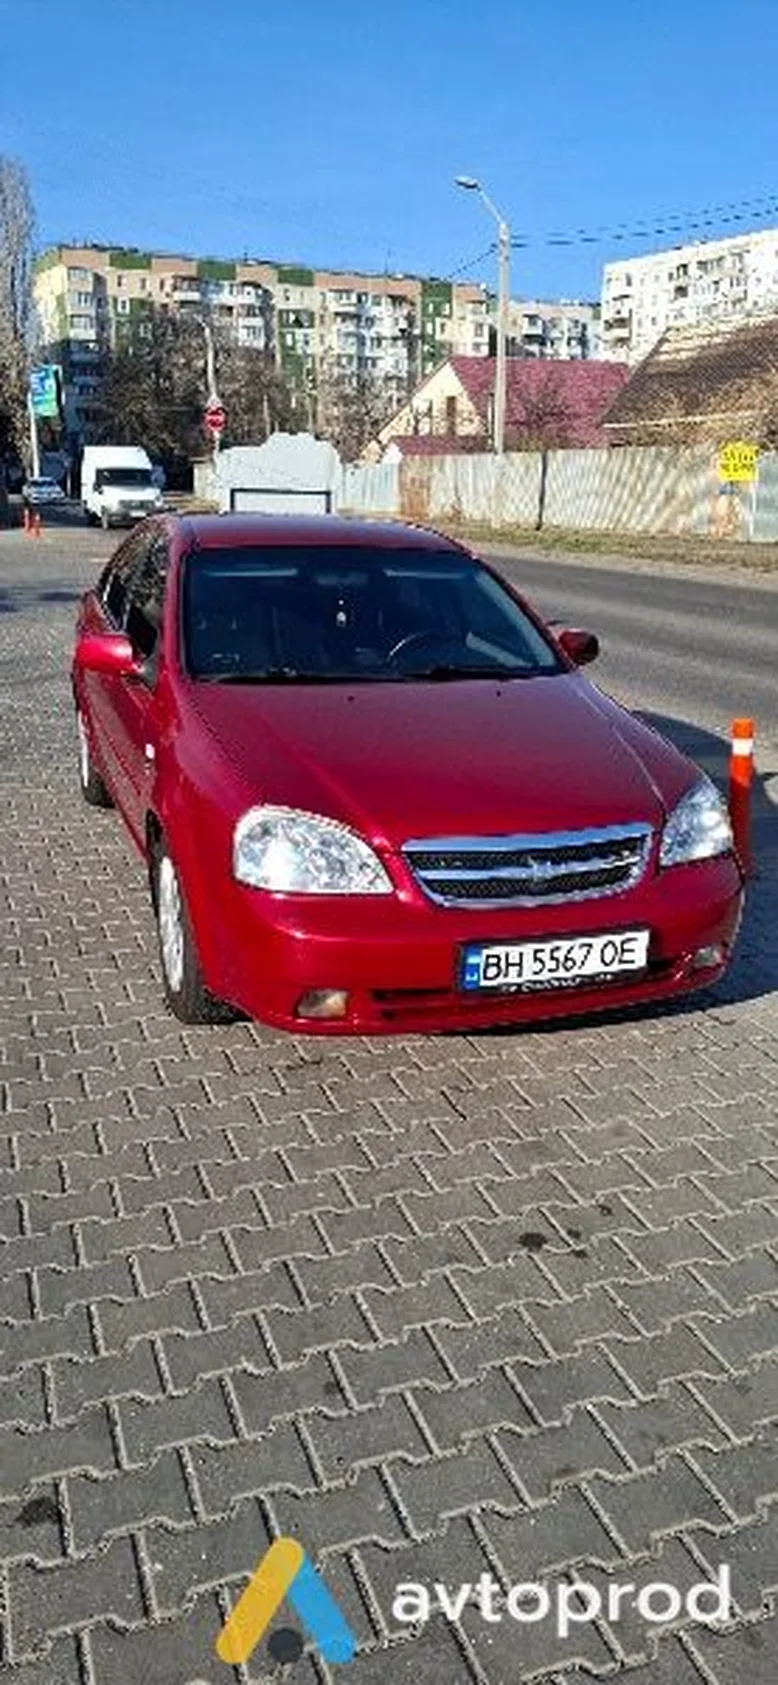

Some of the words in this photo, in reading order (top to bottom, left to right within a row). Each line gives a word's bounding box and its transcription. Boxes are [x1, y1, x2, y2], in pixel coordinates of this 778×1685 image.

[482, 951, 524, 981] BH
[532, 942, 593, 975] 5567
[600, 936, 639, 967] OE
